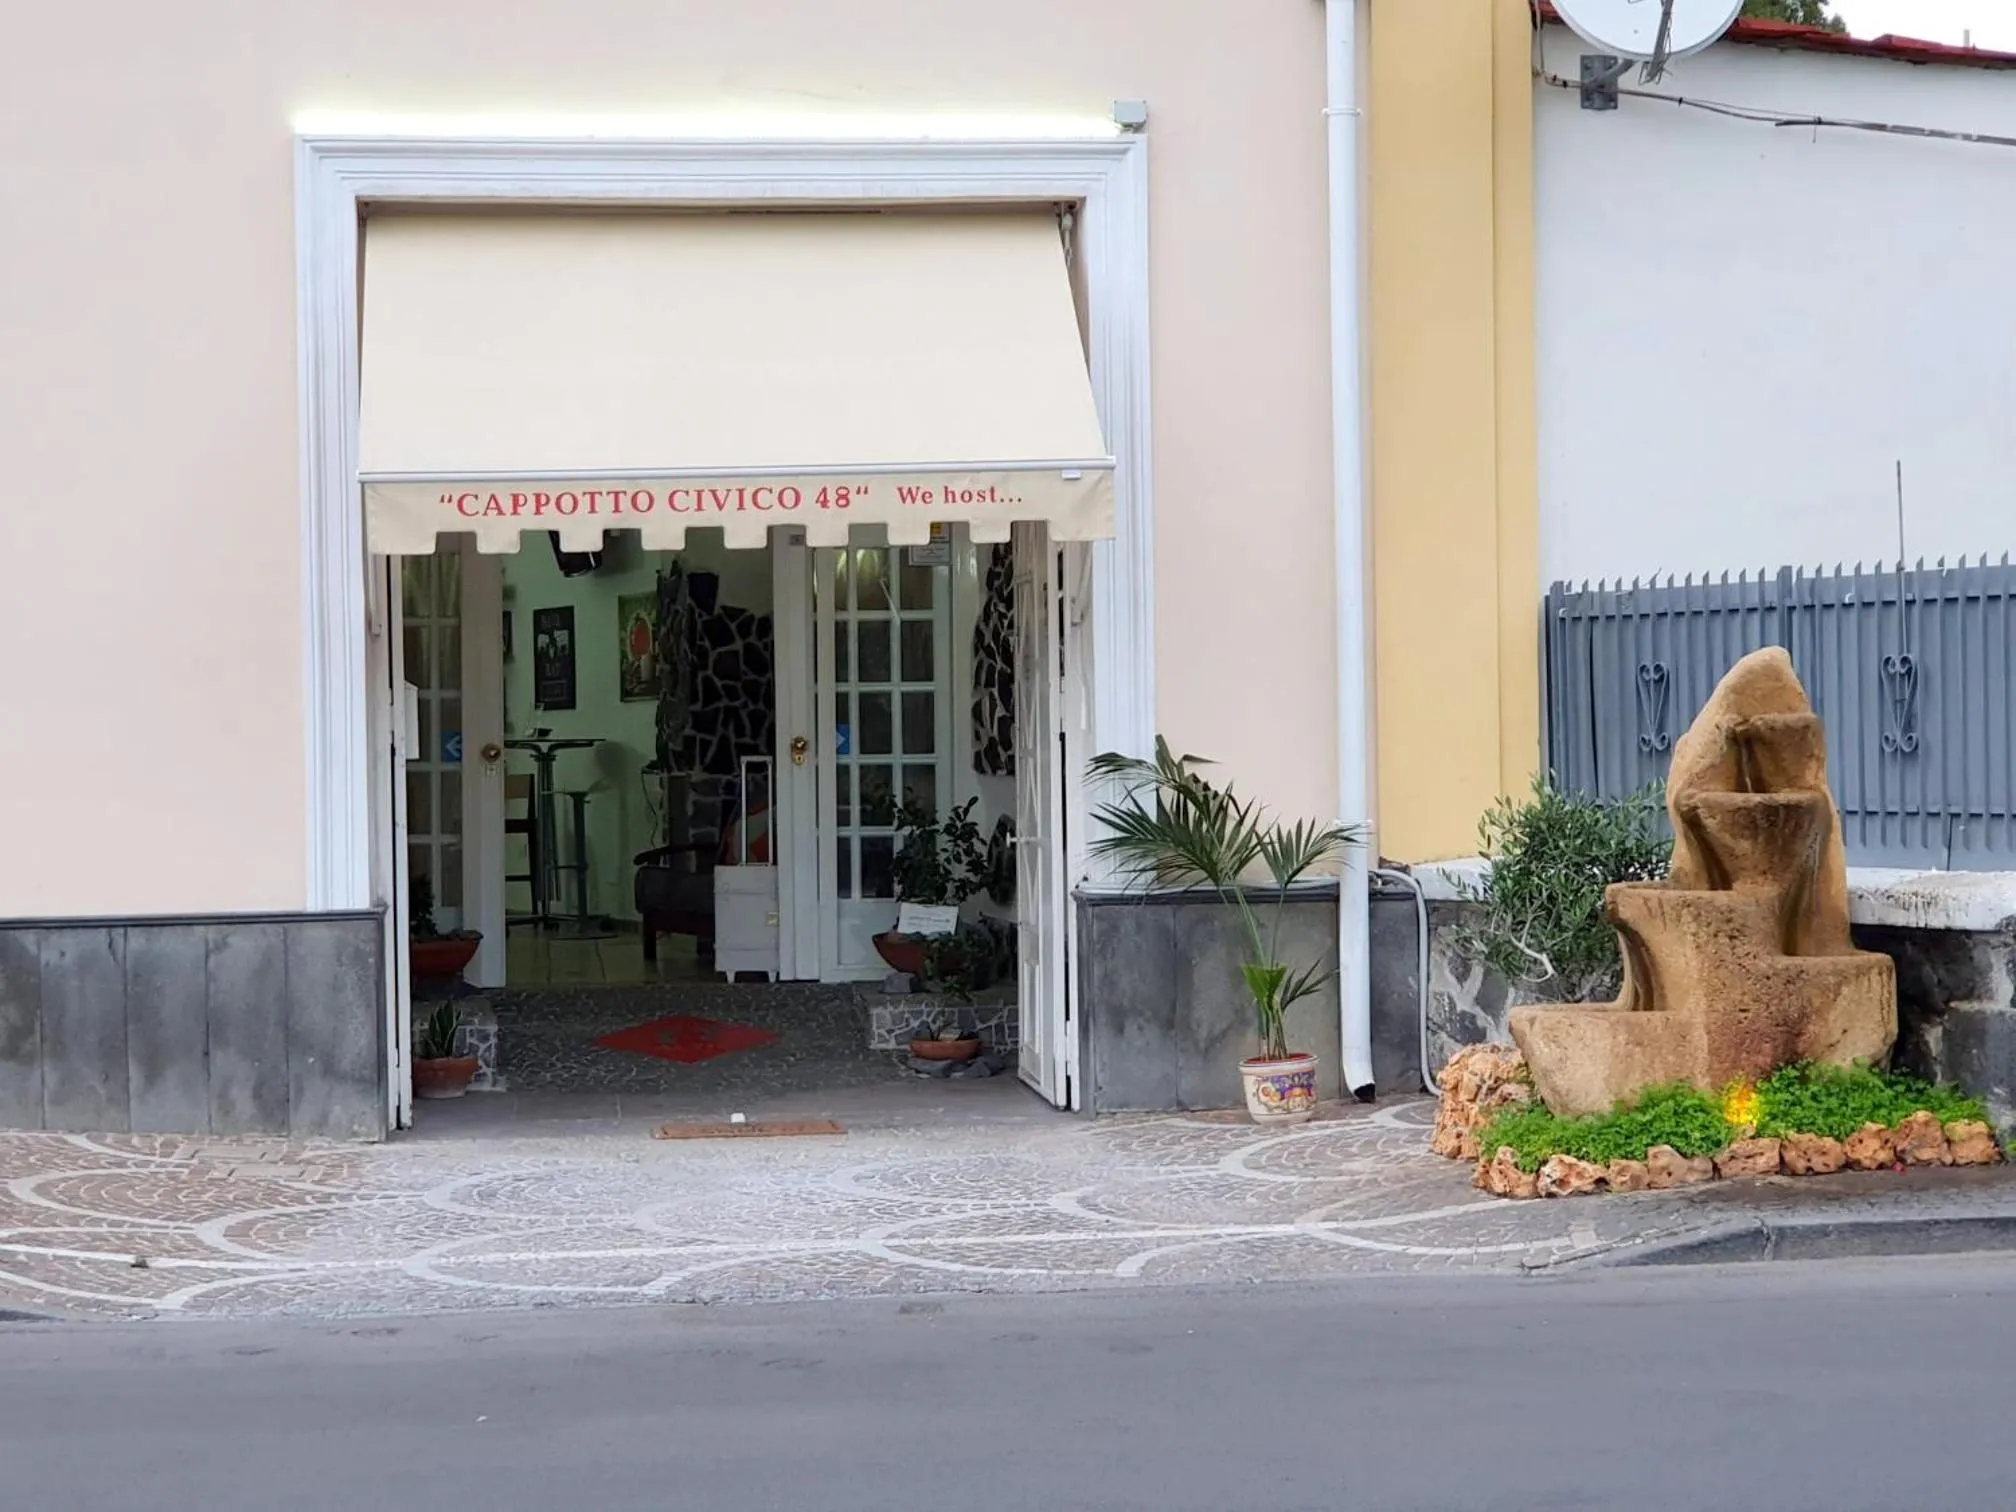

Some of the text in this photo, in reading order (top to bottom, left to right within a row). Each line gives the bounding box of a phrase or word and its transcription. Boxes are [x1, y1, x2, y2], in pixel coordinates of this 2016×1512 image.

[439, 489, 655, 517] “CAPPOTTO
[667, 487, 802, 512] CIVICO
[896, 486, 934, 505] We
[943, 485, 1023, 504] host...
